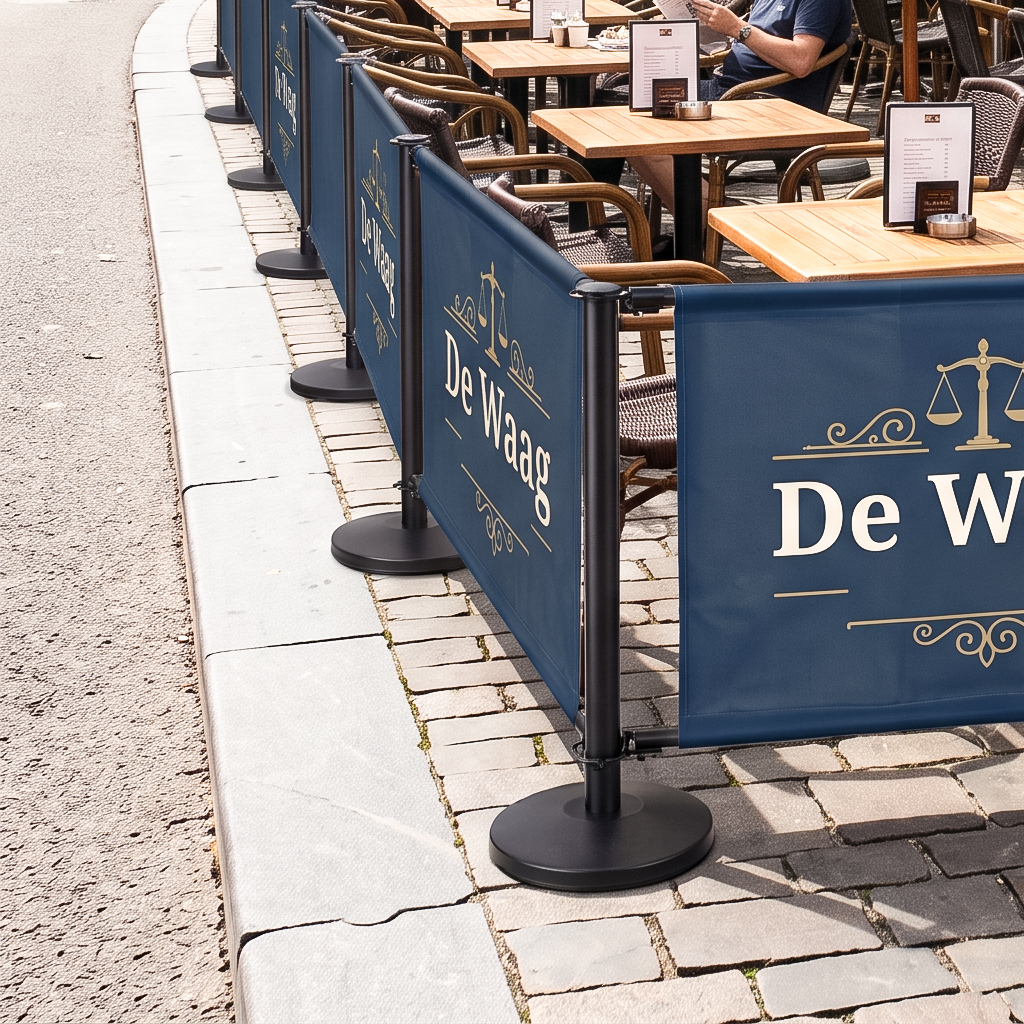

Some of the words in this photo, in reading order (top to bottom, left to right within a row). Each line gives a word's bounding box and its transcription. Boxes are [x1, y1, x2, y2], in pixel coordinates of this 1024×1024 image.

[361, 196, 371, 255] De
[372, 217, 395, 319] Waag
[445, 329, 473, 416] De
[478, 366, 551, 527] Waag
[772, 480, 901, 557] De
